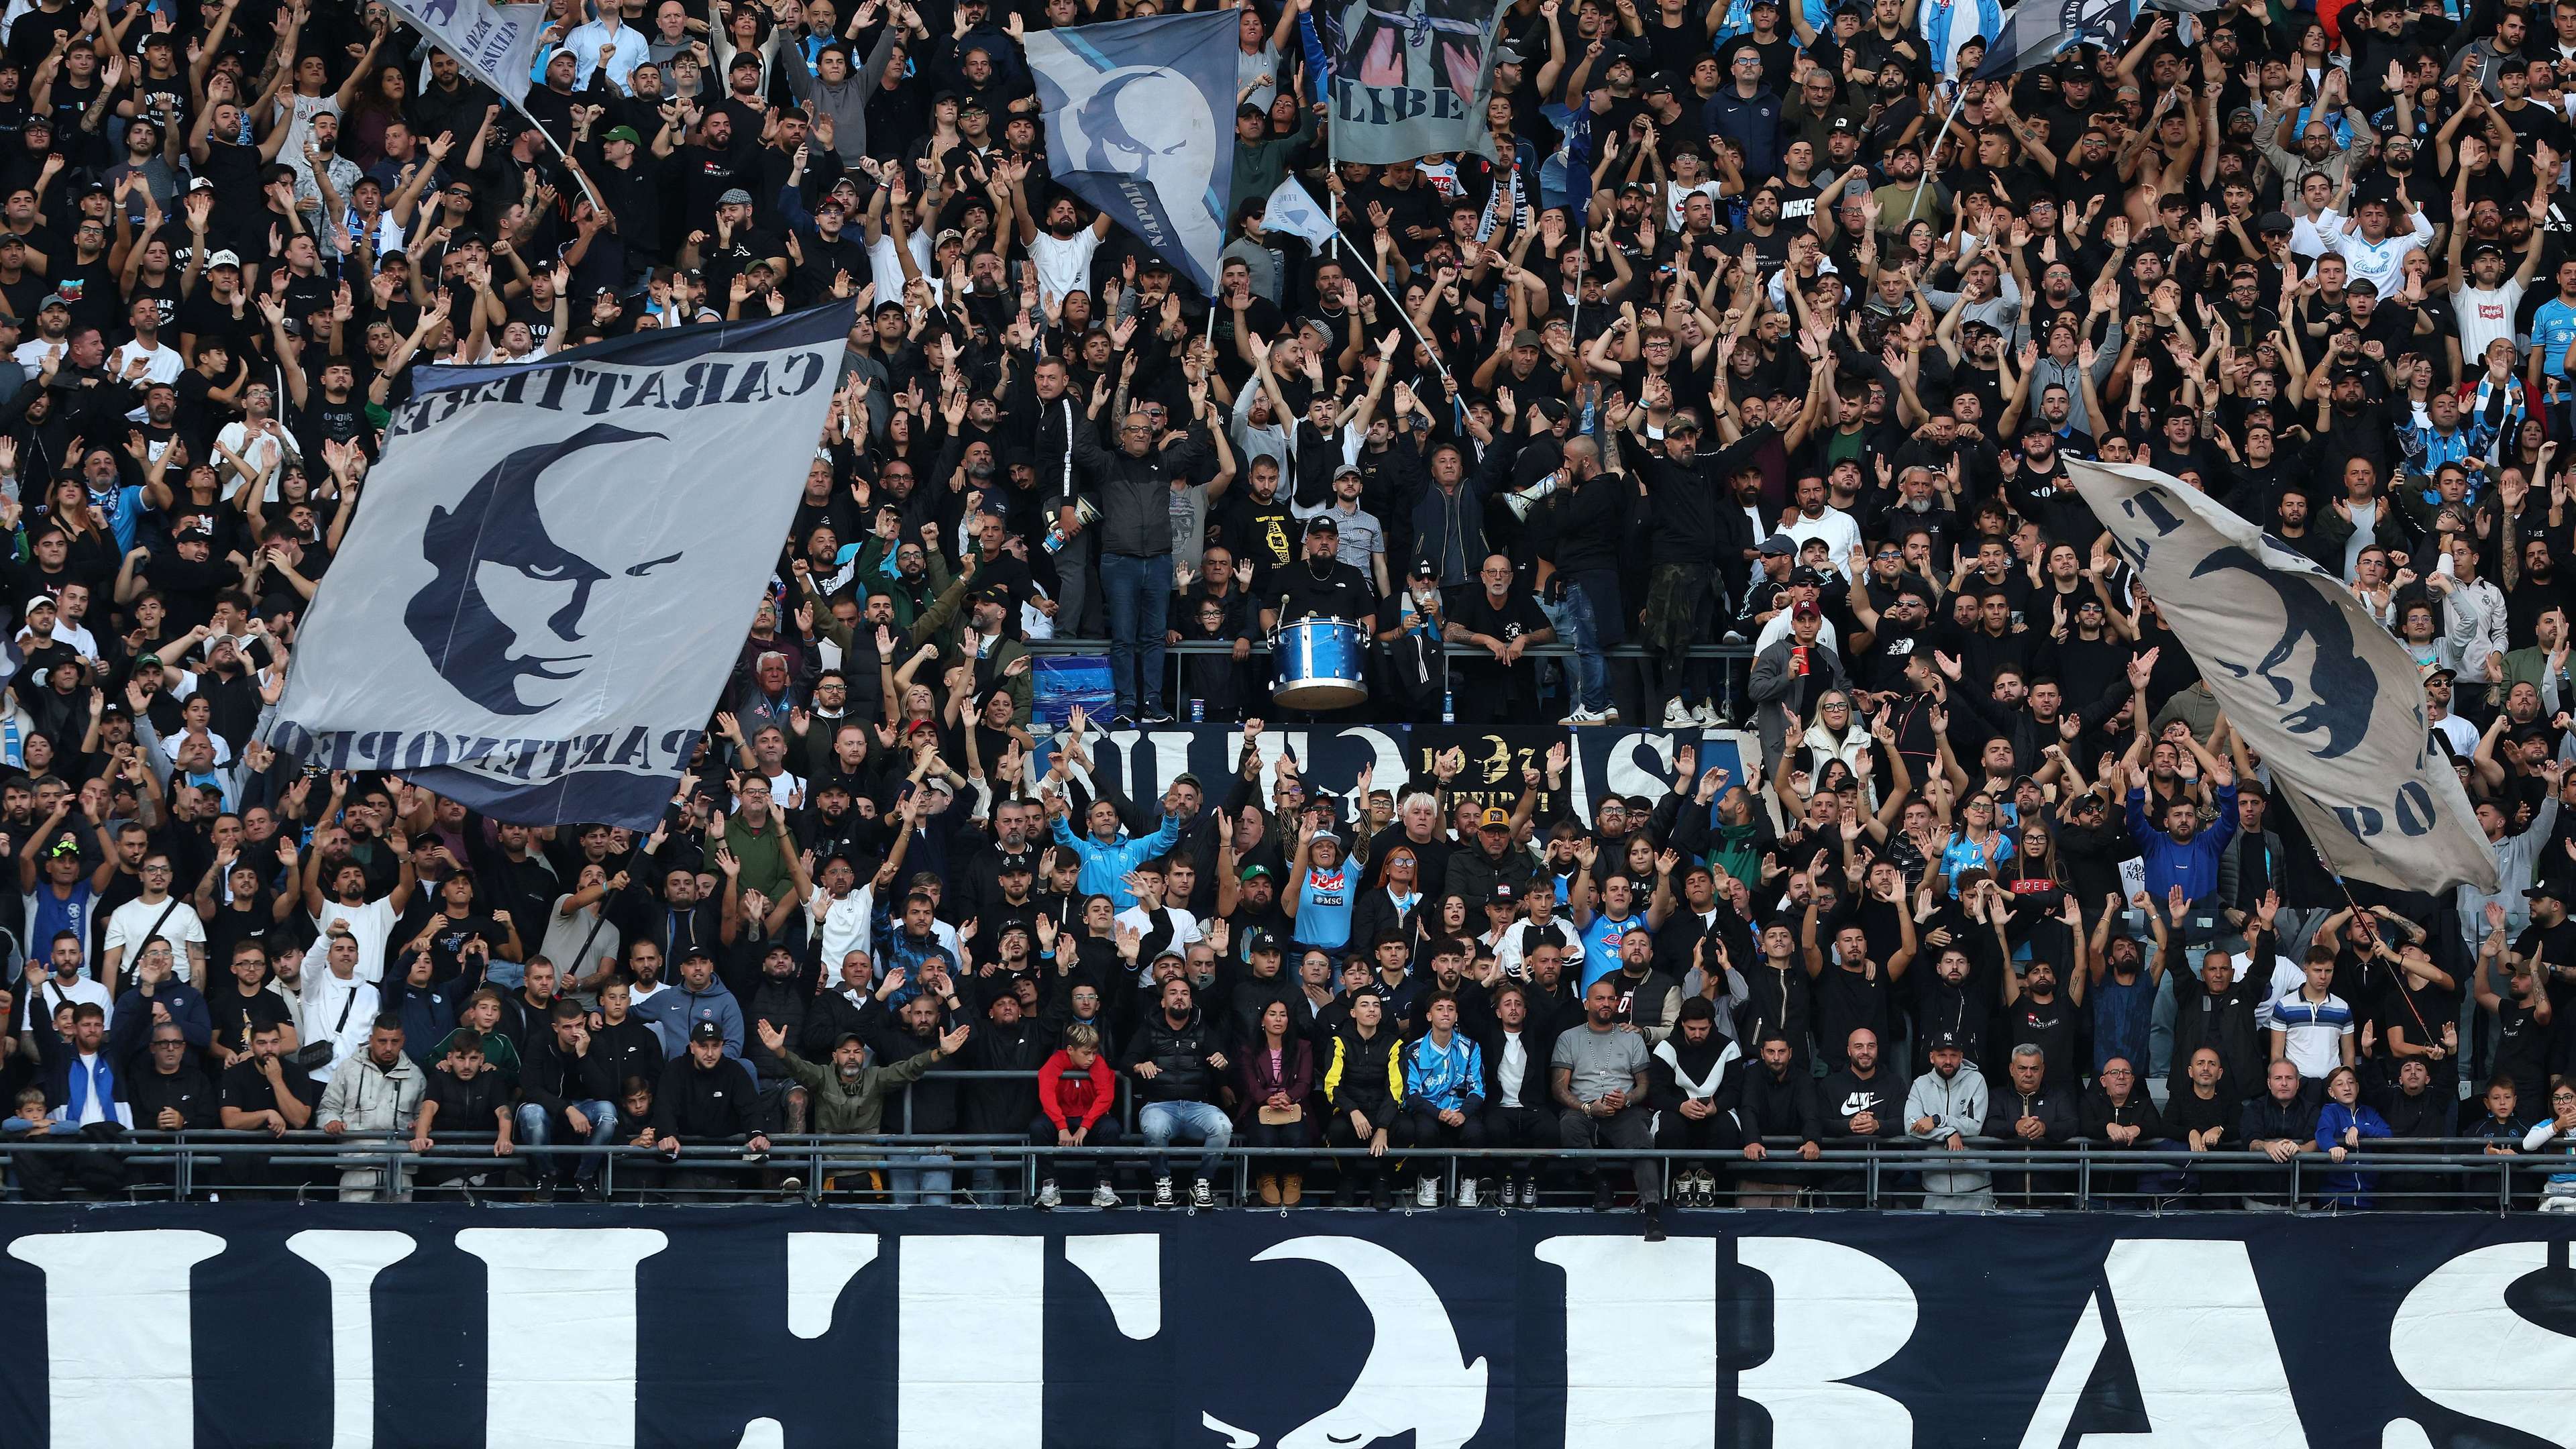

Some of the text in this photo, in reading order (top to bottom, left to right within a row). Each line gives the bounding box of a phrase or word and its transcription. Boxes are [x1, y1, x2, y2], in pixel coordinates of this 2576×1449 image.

[2410, 138, 2424, 151] ay
[1781, 199, 1815, 220] NIKE
[1310, 873, 1344, 892] Lete
[2015, 882, 2049, 892] FREE
[1323, 896, 1343, 905] MSC
[439, 938, 464, 946] NORT
[1264, 934, 1273, 943] NY
[704, 1023, 713, 1032] NY
[1943, 1032, 1953, 1040] NY
